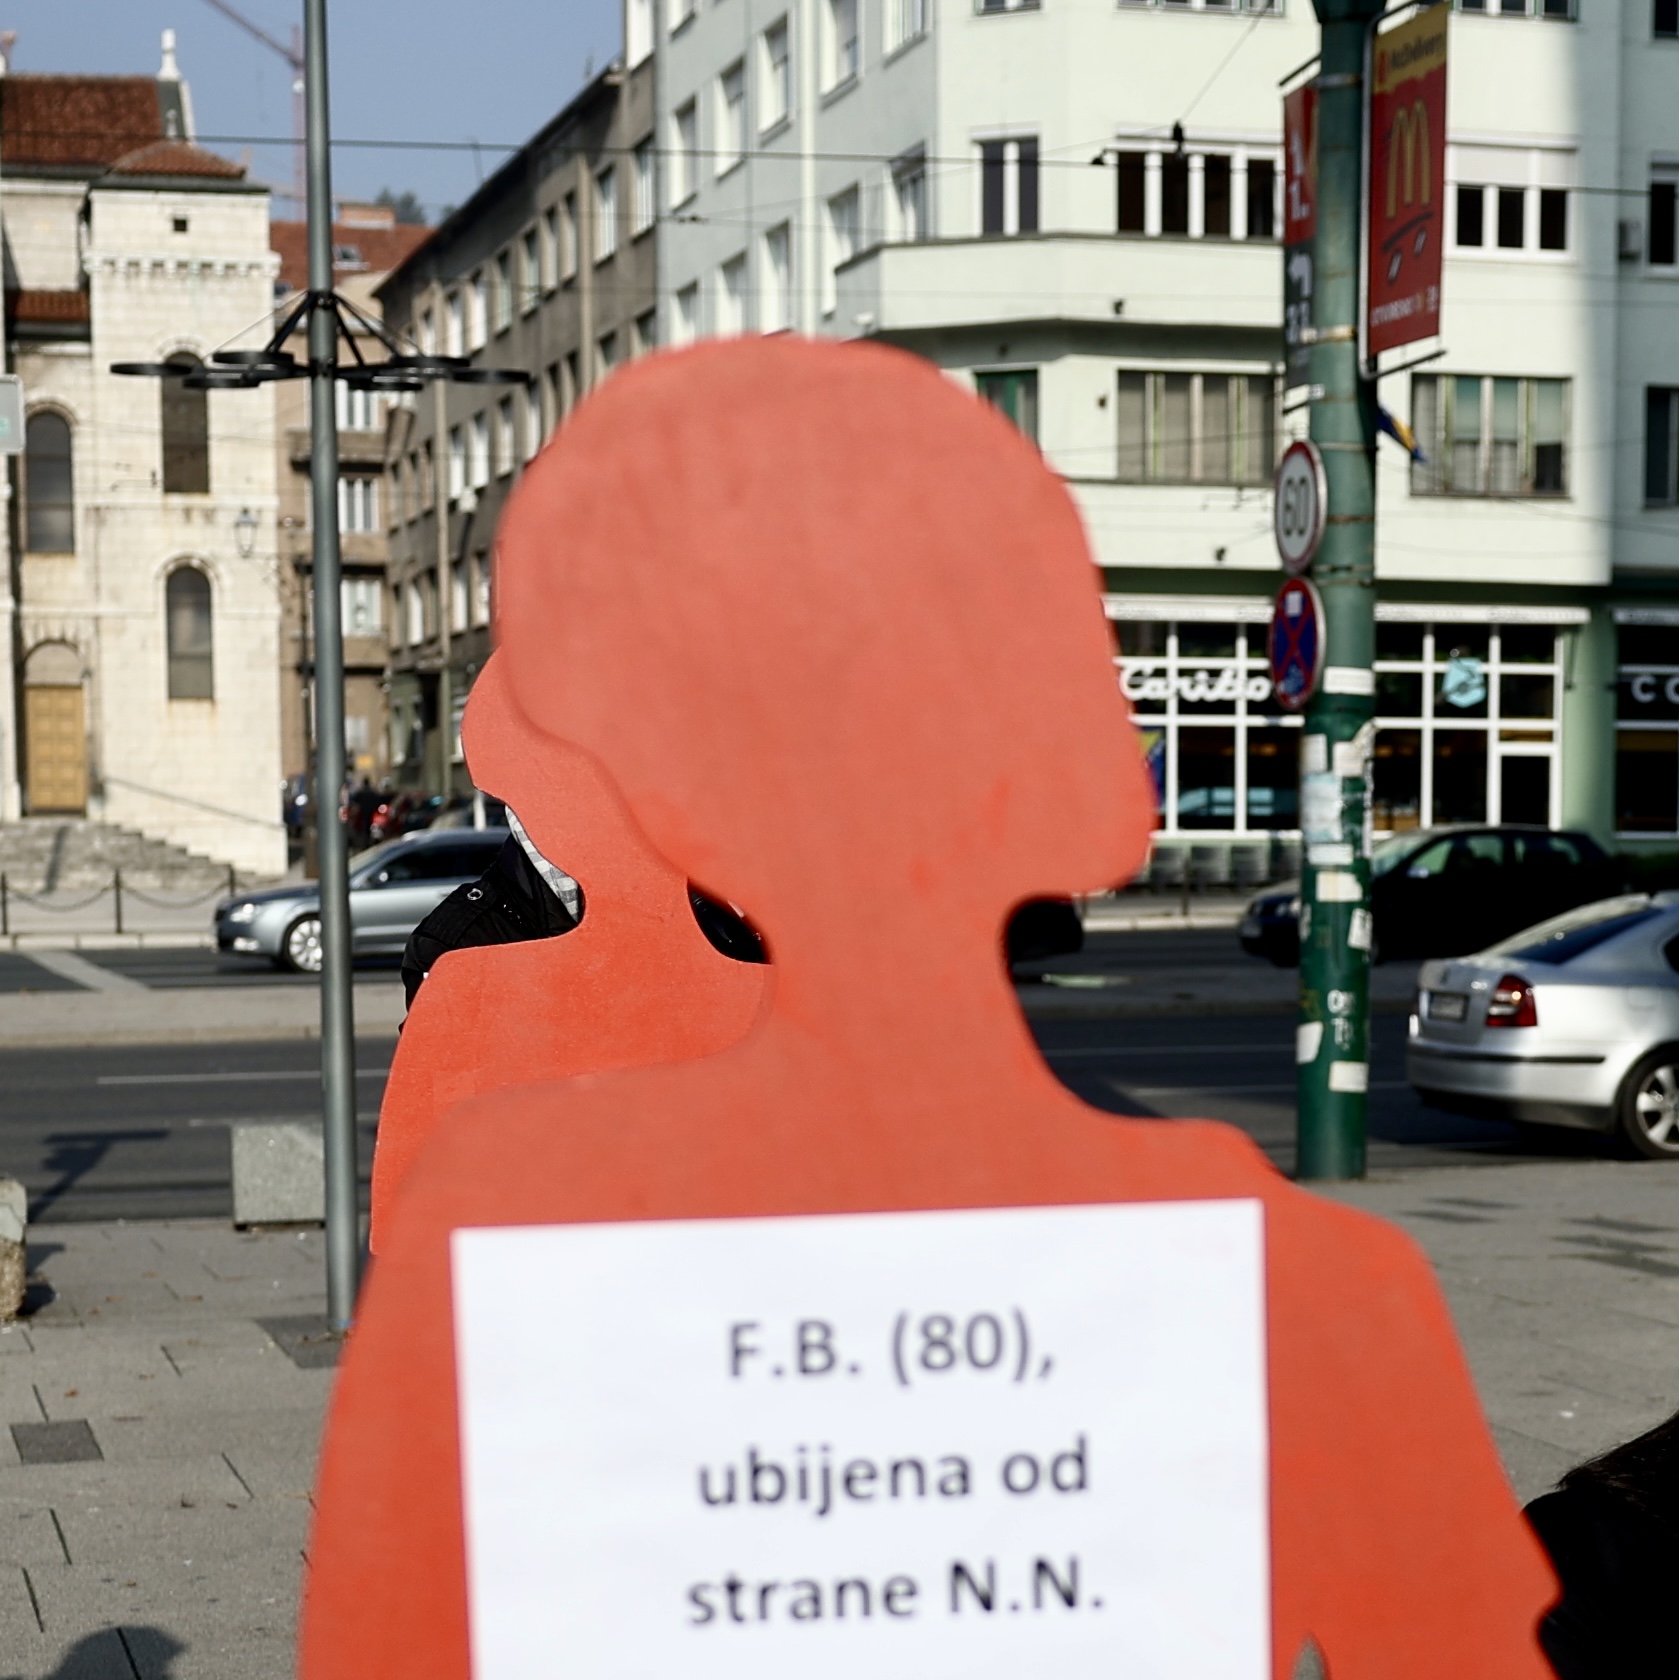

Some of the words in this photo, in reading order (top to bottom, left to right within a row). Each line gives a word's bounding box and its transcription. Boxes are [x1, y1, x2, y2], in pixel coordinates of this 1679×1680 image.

[728, 1319, 860, 1378] F.B.
[891, 1308, 1055, 1387] (80),
[698, 1443, 973, 1519] ubijena
[1000, 1433, 1089, 1497] od
[686, 1573, 920, 1627] strane
[947, 1555, 1105, 1615] N.N.
